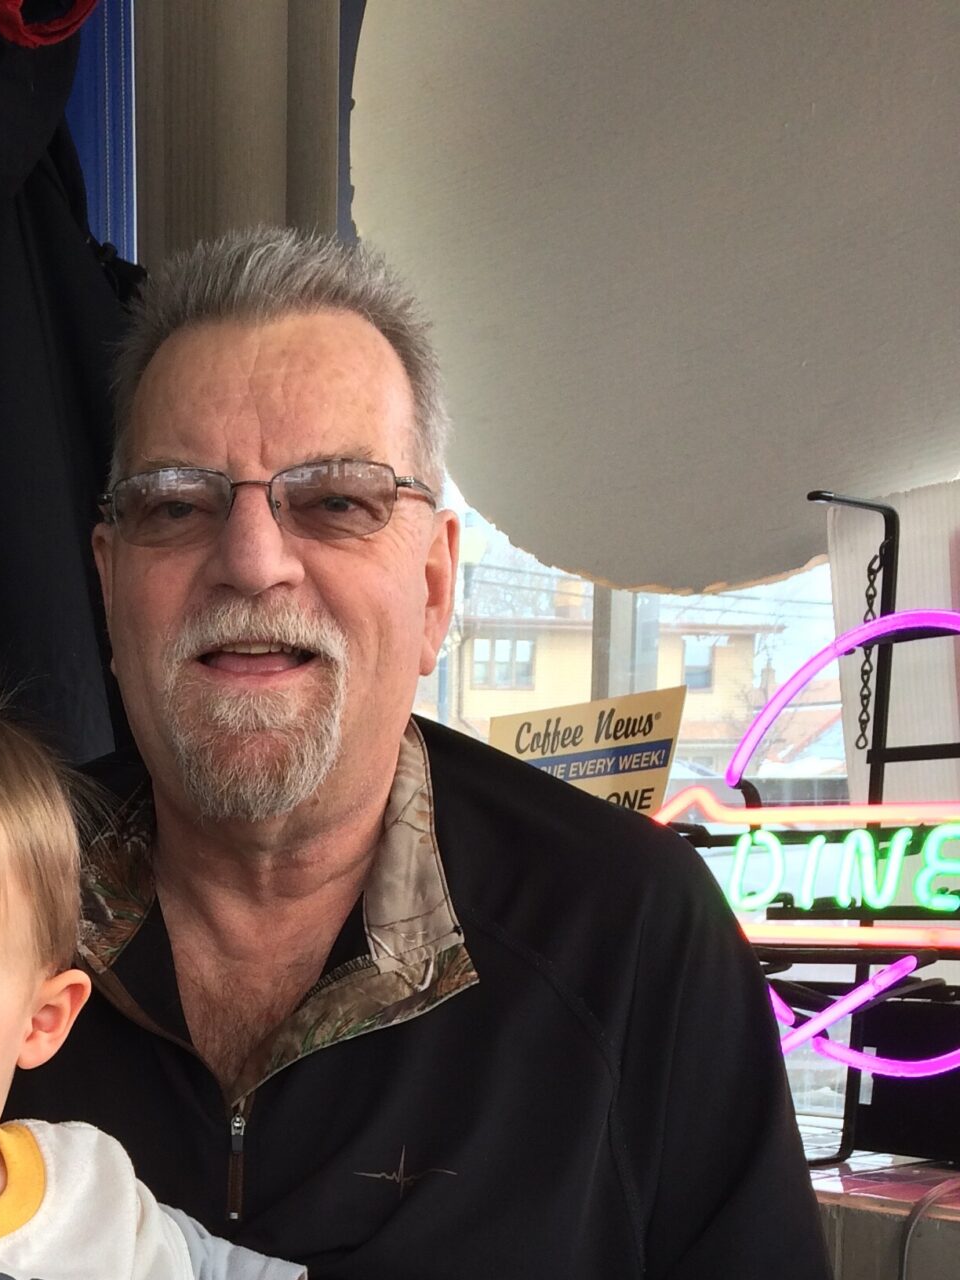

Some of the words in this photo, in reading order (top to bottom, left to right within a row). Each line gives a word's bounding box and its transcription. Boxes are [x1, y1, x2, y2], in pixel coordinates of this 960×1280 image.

[515, 716, 583, 756] Coffee
[568, 757, 616, 778] EVERY
[618, 749, 666, 771] WEEK!
